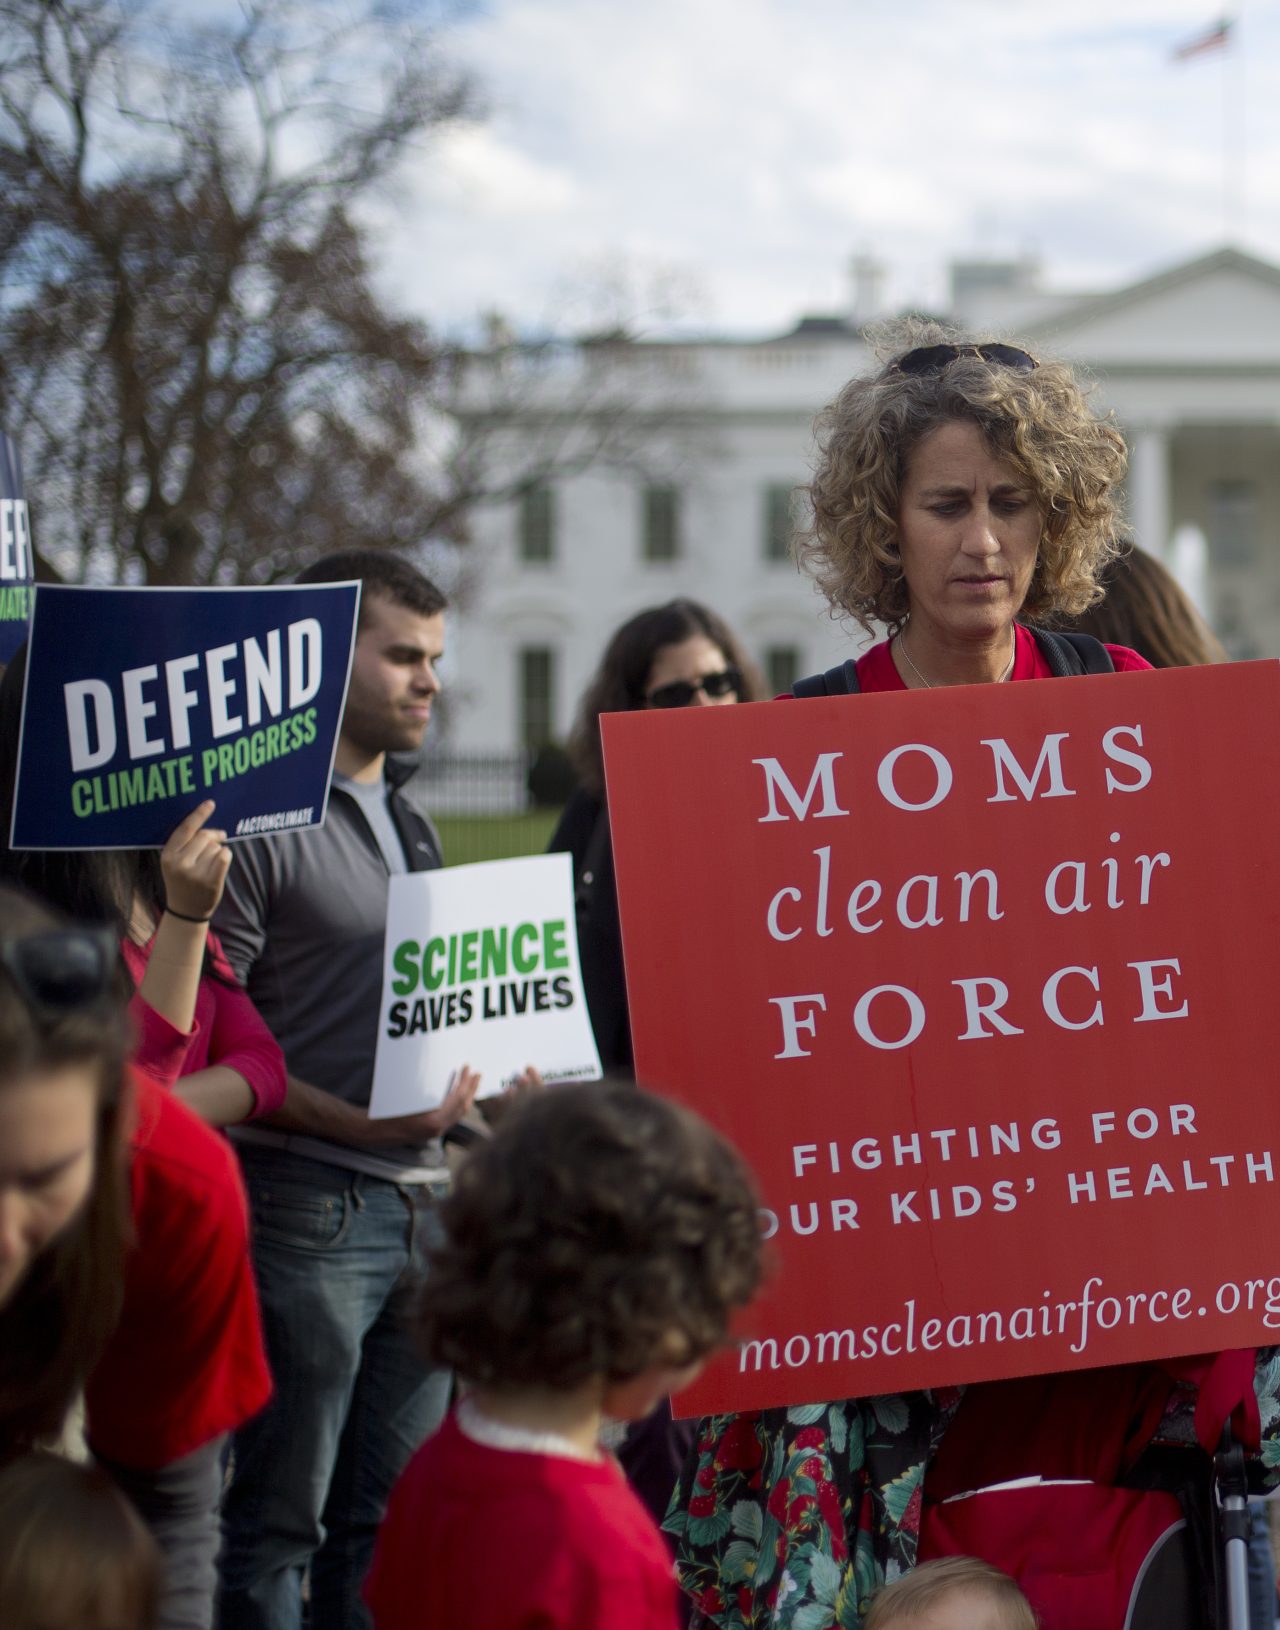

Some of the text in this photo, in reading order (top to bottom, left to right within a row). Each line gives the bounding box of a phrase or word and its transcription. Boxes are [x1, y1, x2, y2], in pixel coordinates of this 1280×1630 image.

[64, 617, 322, 773] DEFEND
[71, 707, 318, 818] CLIMATE PROGRESS
[752, 724, 1153, 823] MOMS
[767, 832, 1171, 942] clean air
[392, 919, 570, 996] SCIENCE
[387, 975, 575, 1040] SAVES LIVES
[768, 958, 1190, 1059] FORCE
[792, 1103, 1199, 1178] FIGHTING FOR
[755, 1198, 861, 1240] OUR
[1067, 1151, 1275, 1205] HEALTH
